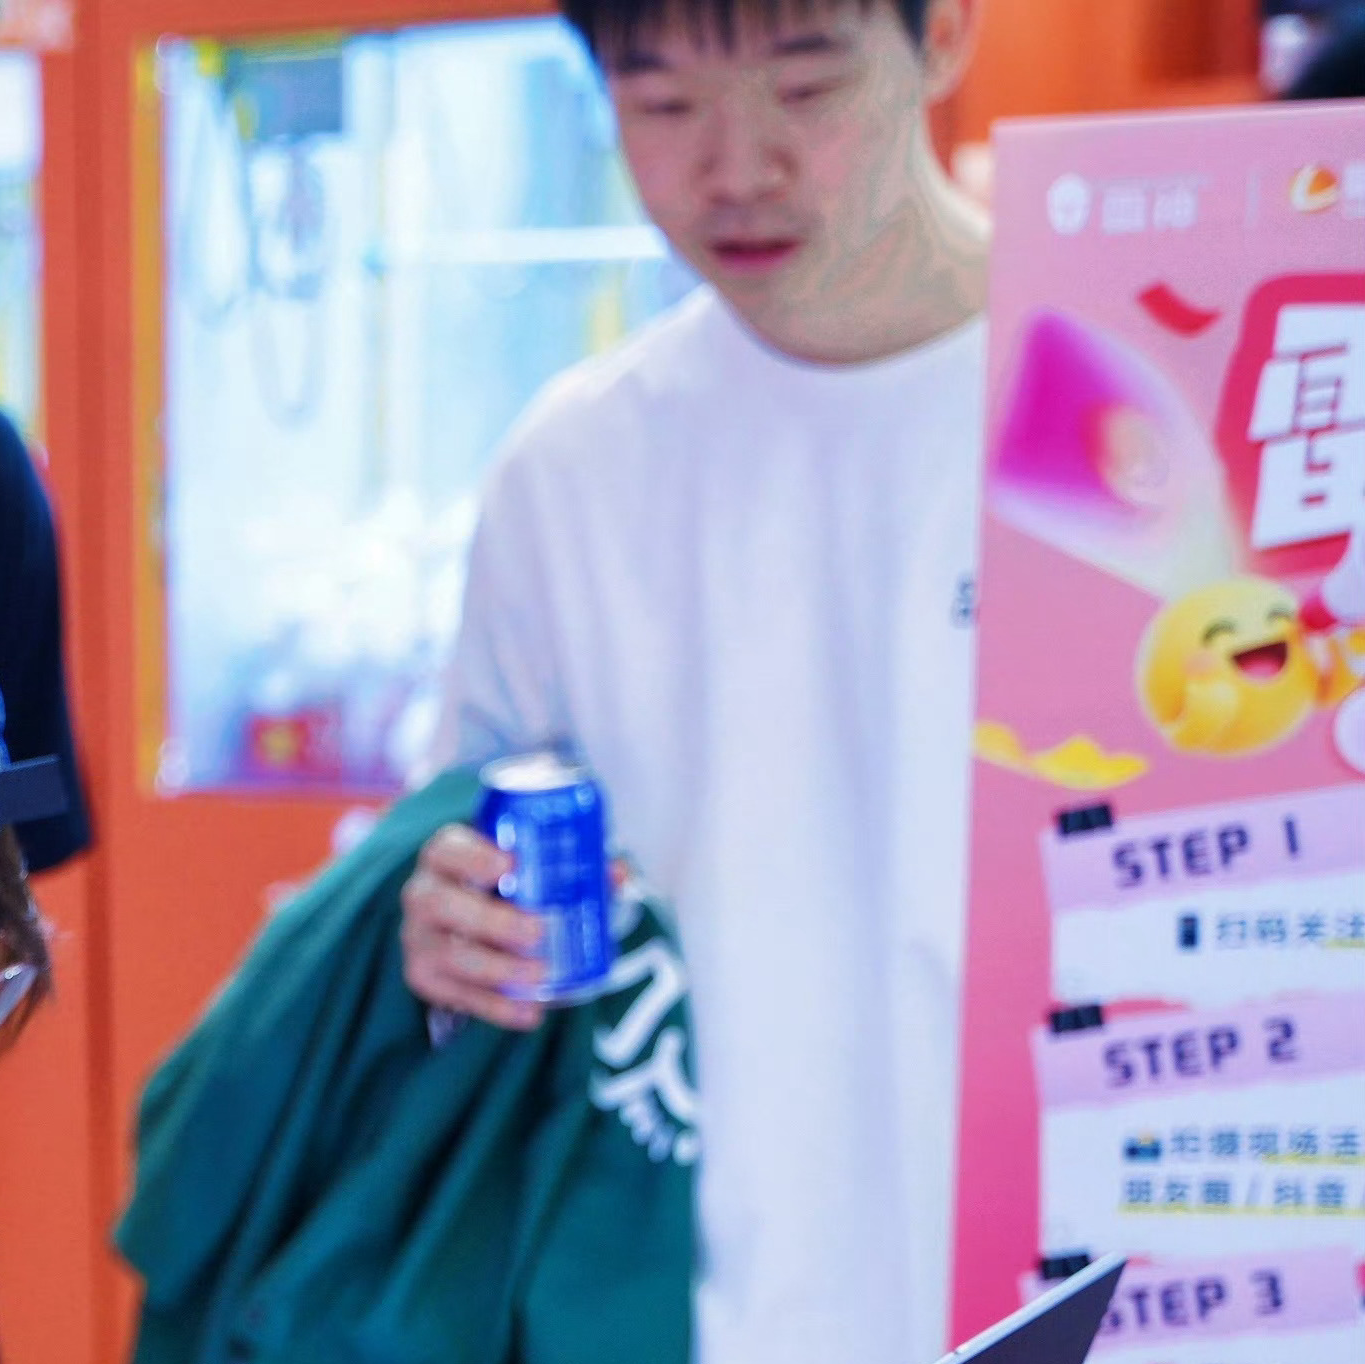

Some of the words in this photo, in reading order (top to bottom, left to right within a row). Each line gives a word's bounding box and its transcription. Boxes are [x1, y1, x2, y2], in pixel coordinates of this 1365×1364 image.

[1111, 825, 1249, 888] STEP
[1283, 815, 1302, 860] 1
[1102, 1025, 1239, 1088] STEP
[1264, 1016, 1299, 1064] 2
[1249, 1268, 1285, 1315] 3
